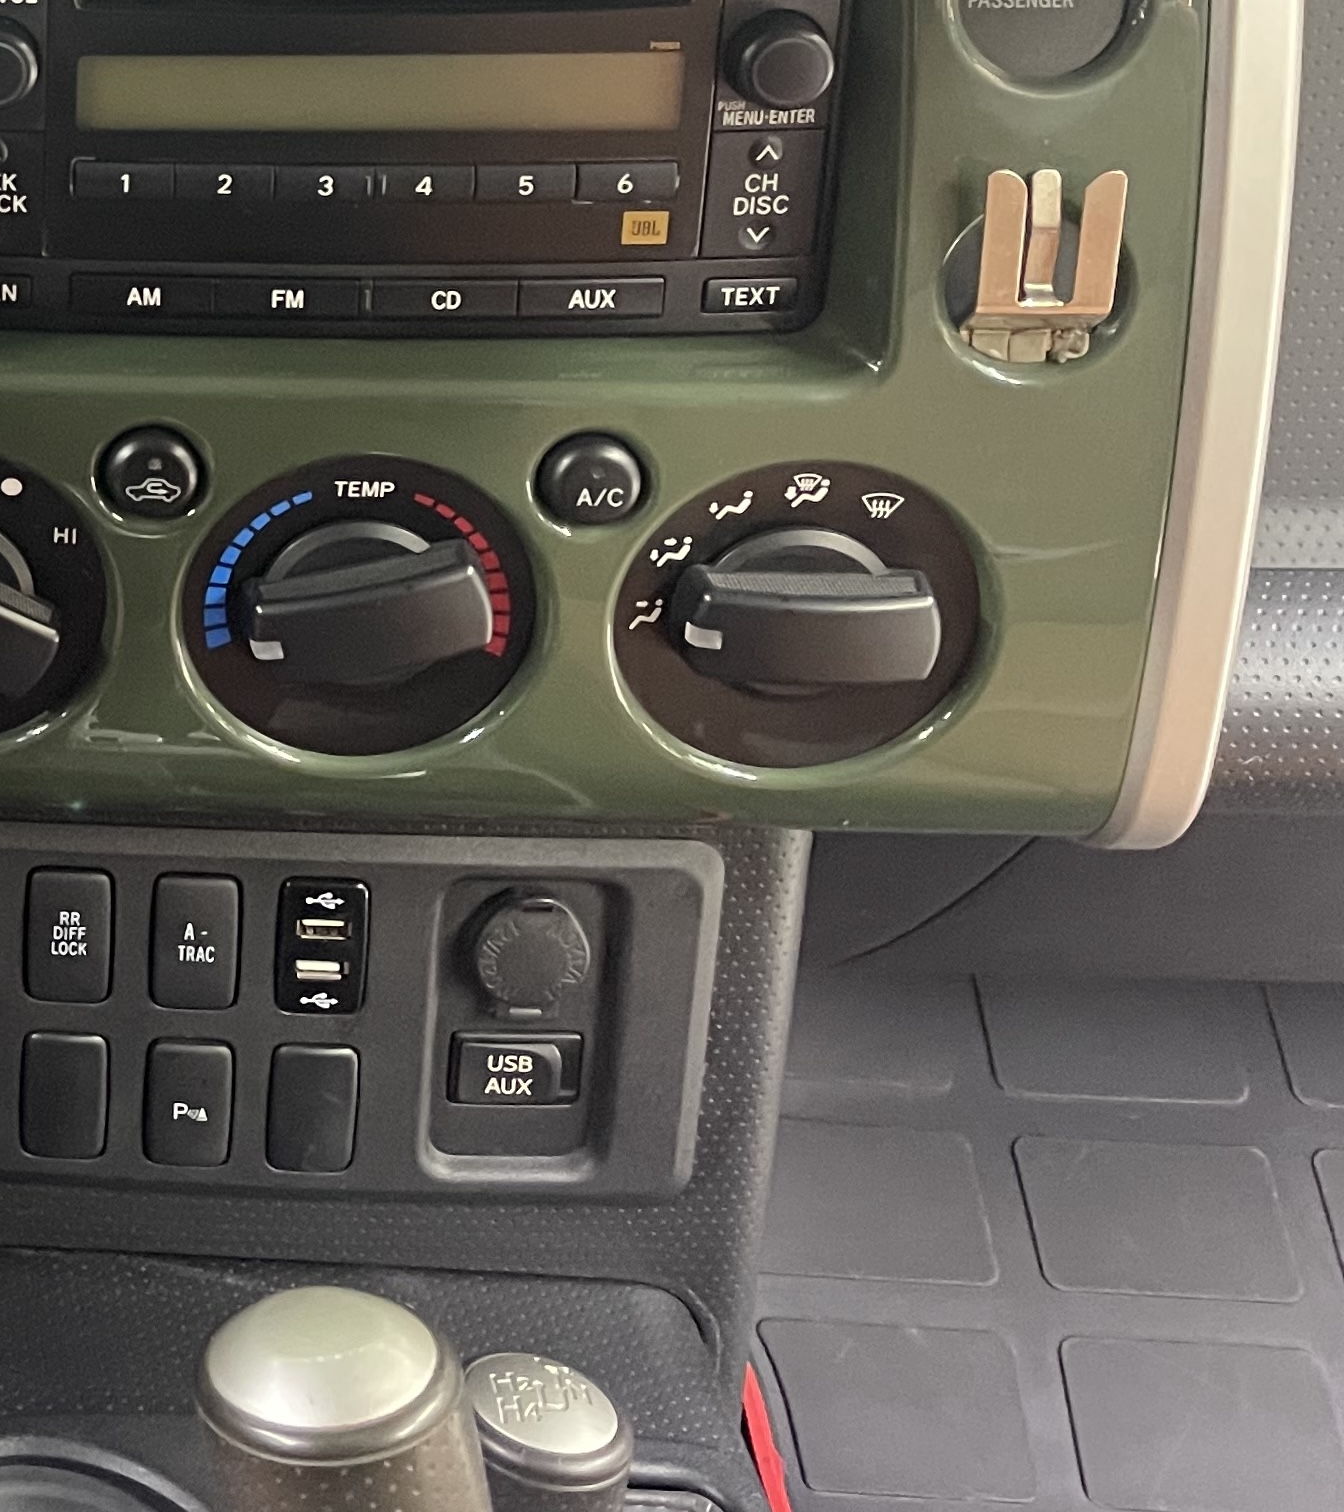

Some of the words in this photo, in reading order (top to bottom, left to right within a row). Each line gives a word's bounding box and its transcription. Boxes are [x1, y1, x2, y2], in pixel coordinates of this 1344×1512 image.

[717, 100, 746, 111] PUSH
[119, 174, 130, 193] 1
[217, 174, 233, 194] 2
[317, 175, 334, 196] 3
[415, 176, 433, 196] 4
[518, 175, 534, 196] 5
[617, 174, 633, 194] 6
[744, 173, 779, 193] CH
[732, 195, 790, 216] DISC
[632, 220, 661, 236] JBL
[126, 288, 162, 307] AM
[271, 290, 305, 309] FM
[431, 290, 461, 310] CD
[568, 289, 616, 309] AUX
[721, 286, 780, 306] TEXT
[334, 481, 395, 499] TEMP
[576, 487, 625, 508] A/C
[53, 527, 77, 545] HI
[59, 911, 80, 926] RR
[53, 926, 87, 940] DIFF
[51, 941, 87, 957] LOCK
[177, 945, 216, 963] TRAC
[487, 1055, 533, 1073] USB
[485, 1078, 533, 1096] AUX
